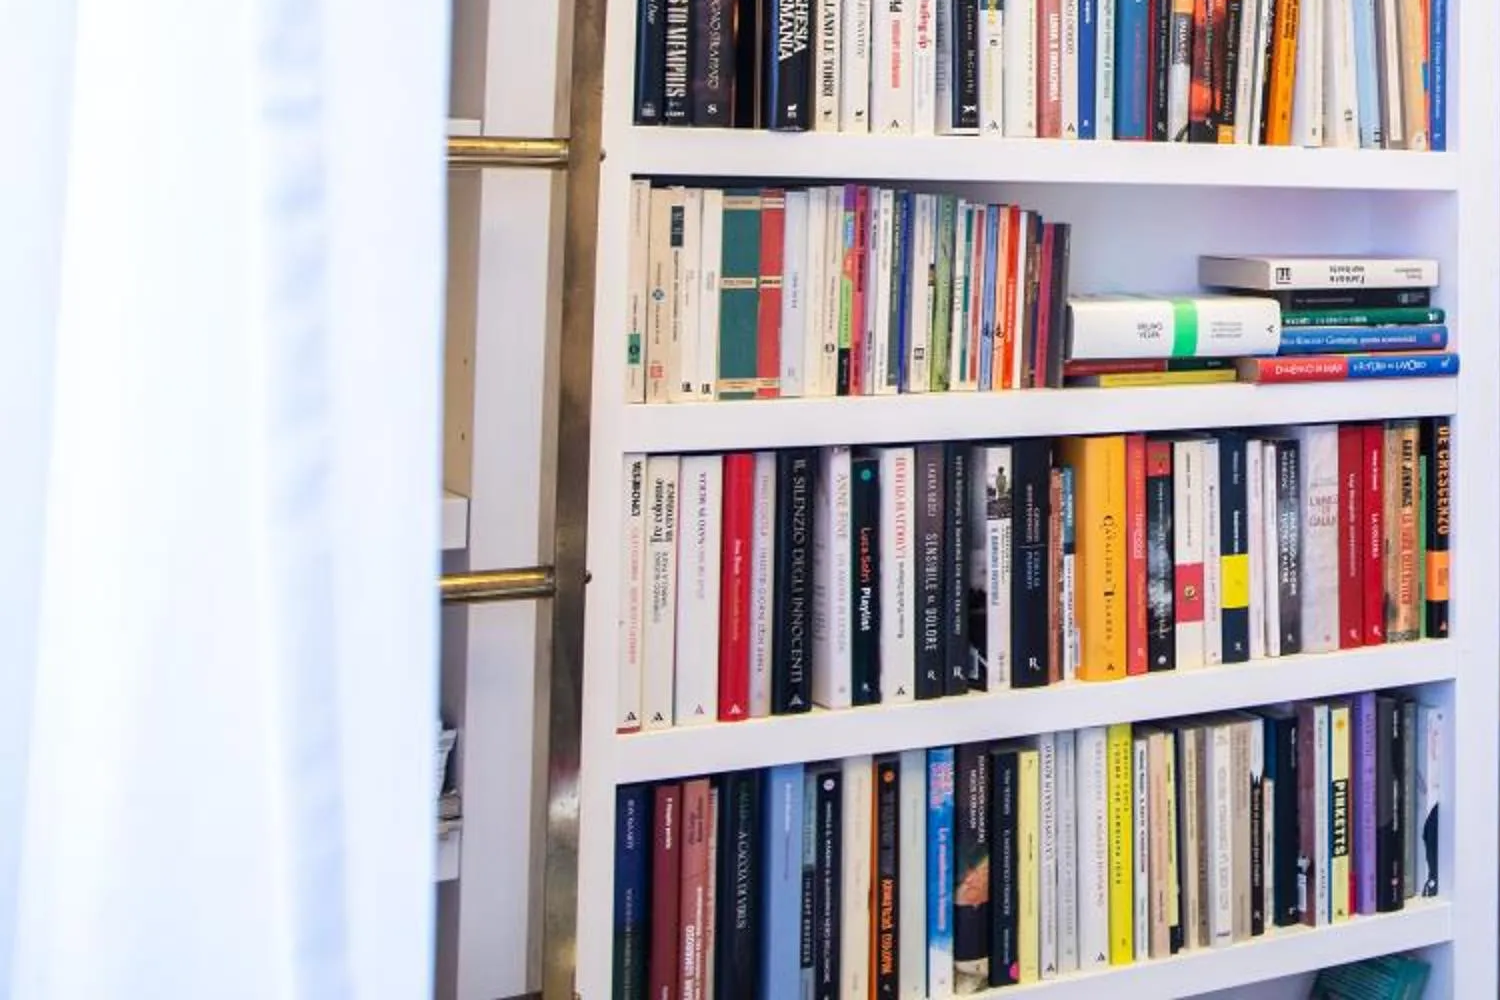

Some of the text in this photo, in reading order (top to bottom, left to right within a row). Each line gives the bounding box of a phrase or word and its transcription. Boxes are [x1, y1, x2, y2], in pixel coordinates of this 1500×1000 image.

[665, 27, 686, 97] MEMPHIS
[822, 58, 834, 97] TORRI
[793, 476, 806, 544] SILENZIO
[1437, 426, 1449, 535] DE CRESCENZO
[792, 548, 805, 592] DEGLI
[925, 533, 937, 590] SENSIBILE
[790, 597, 804, 682] INNOCENTI
[859, 587, 871, 631] Playlist
[925, 607, 937, 652] DOLORE
[1334, 781, 1346, 856] PINKETTS
